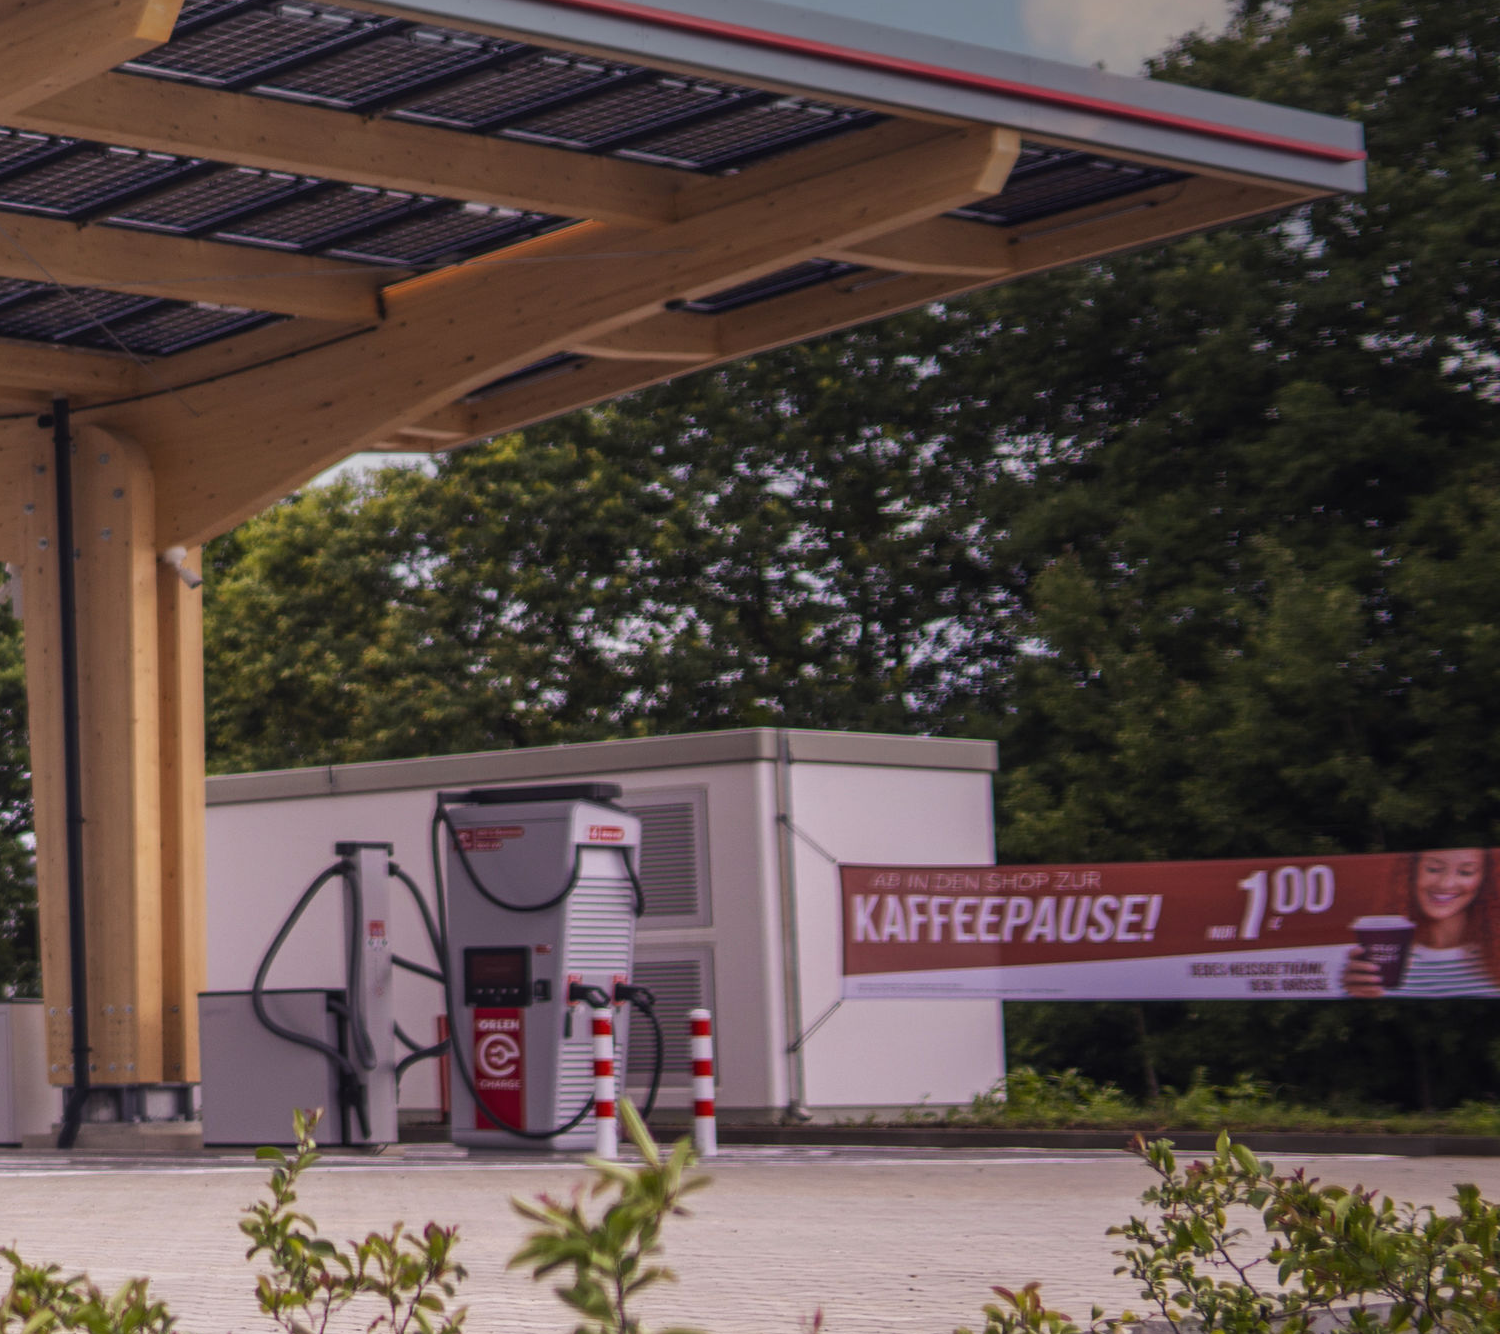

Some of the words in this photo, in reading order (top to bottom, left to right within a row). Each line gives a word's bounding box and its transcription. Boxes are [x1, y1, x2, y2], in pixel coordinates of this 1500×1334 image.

[873, 873, 900, 889] AB
[907, 873, 929, 890] IN
[936, 874, 980, 890] DEN
[986, 873, 1050, 891] SHOP
[1054, 871, 1102, 890] ZUR
[852, 894, 1164, 943] KAFFEEPAUSE!
